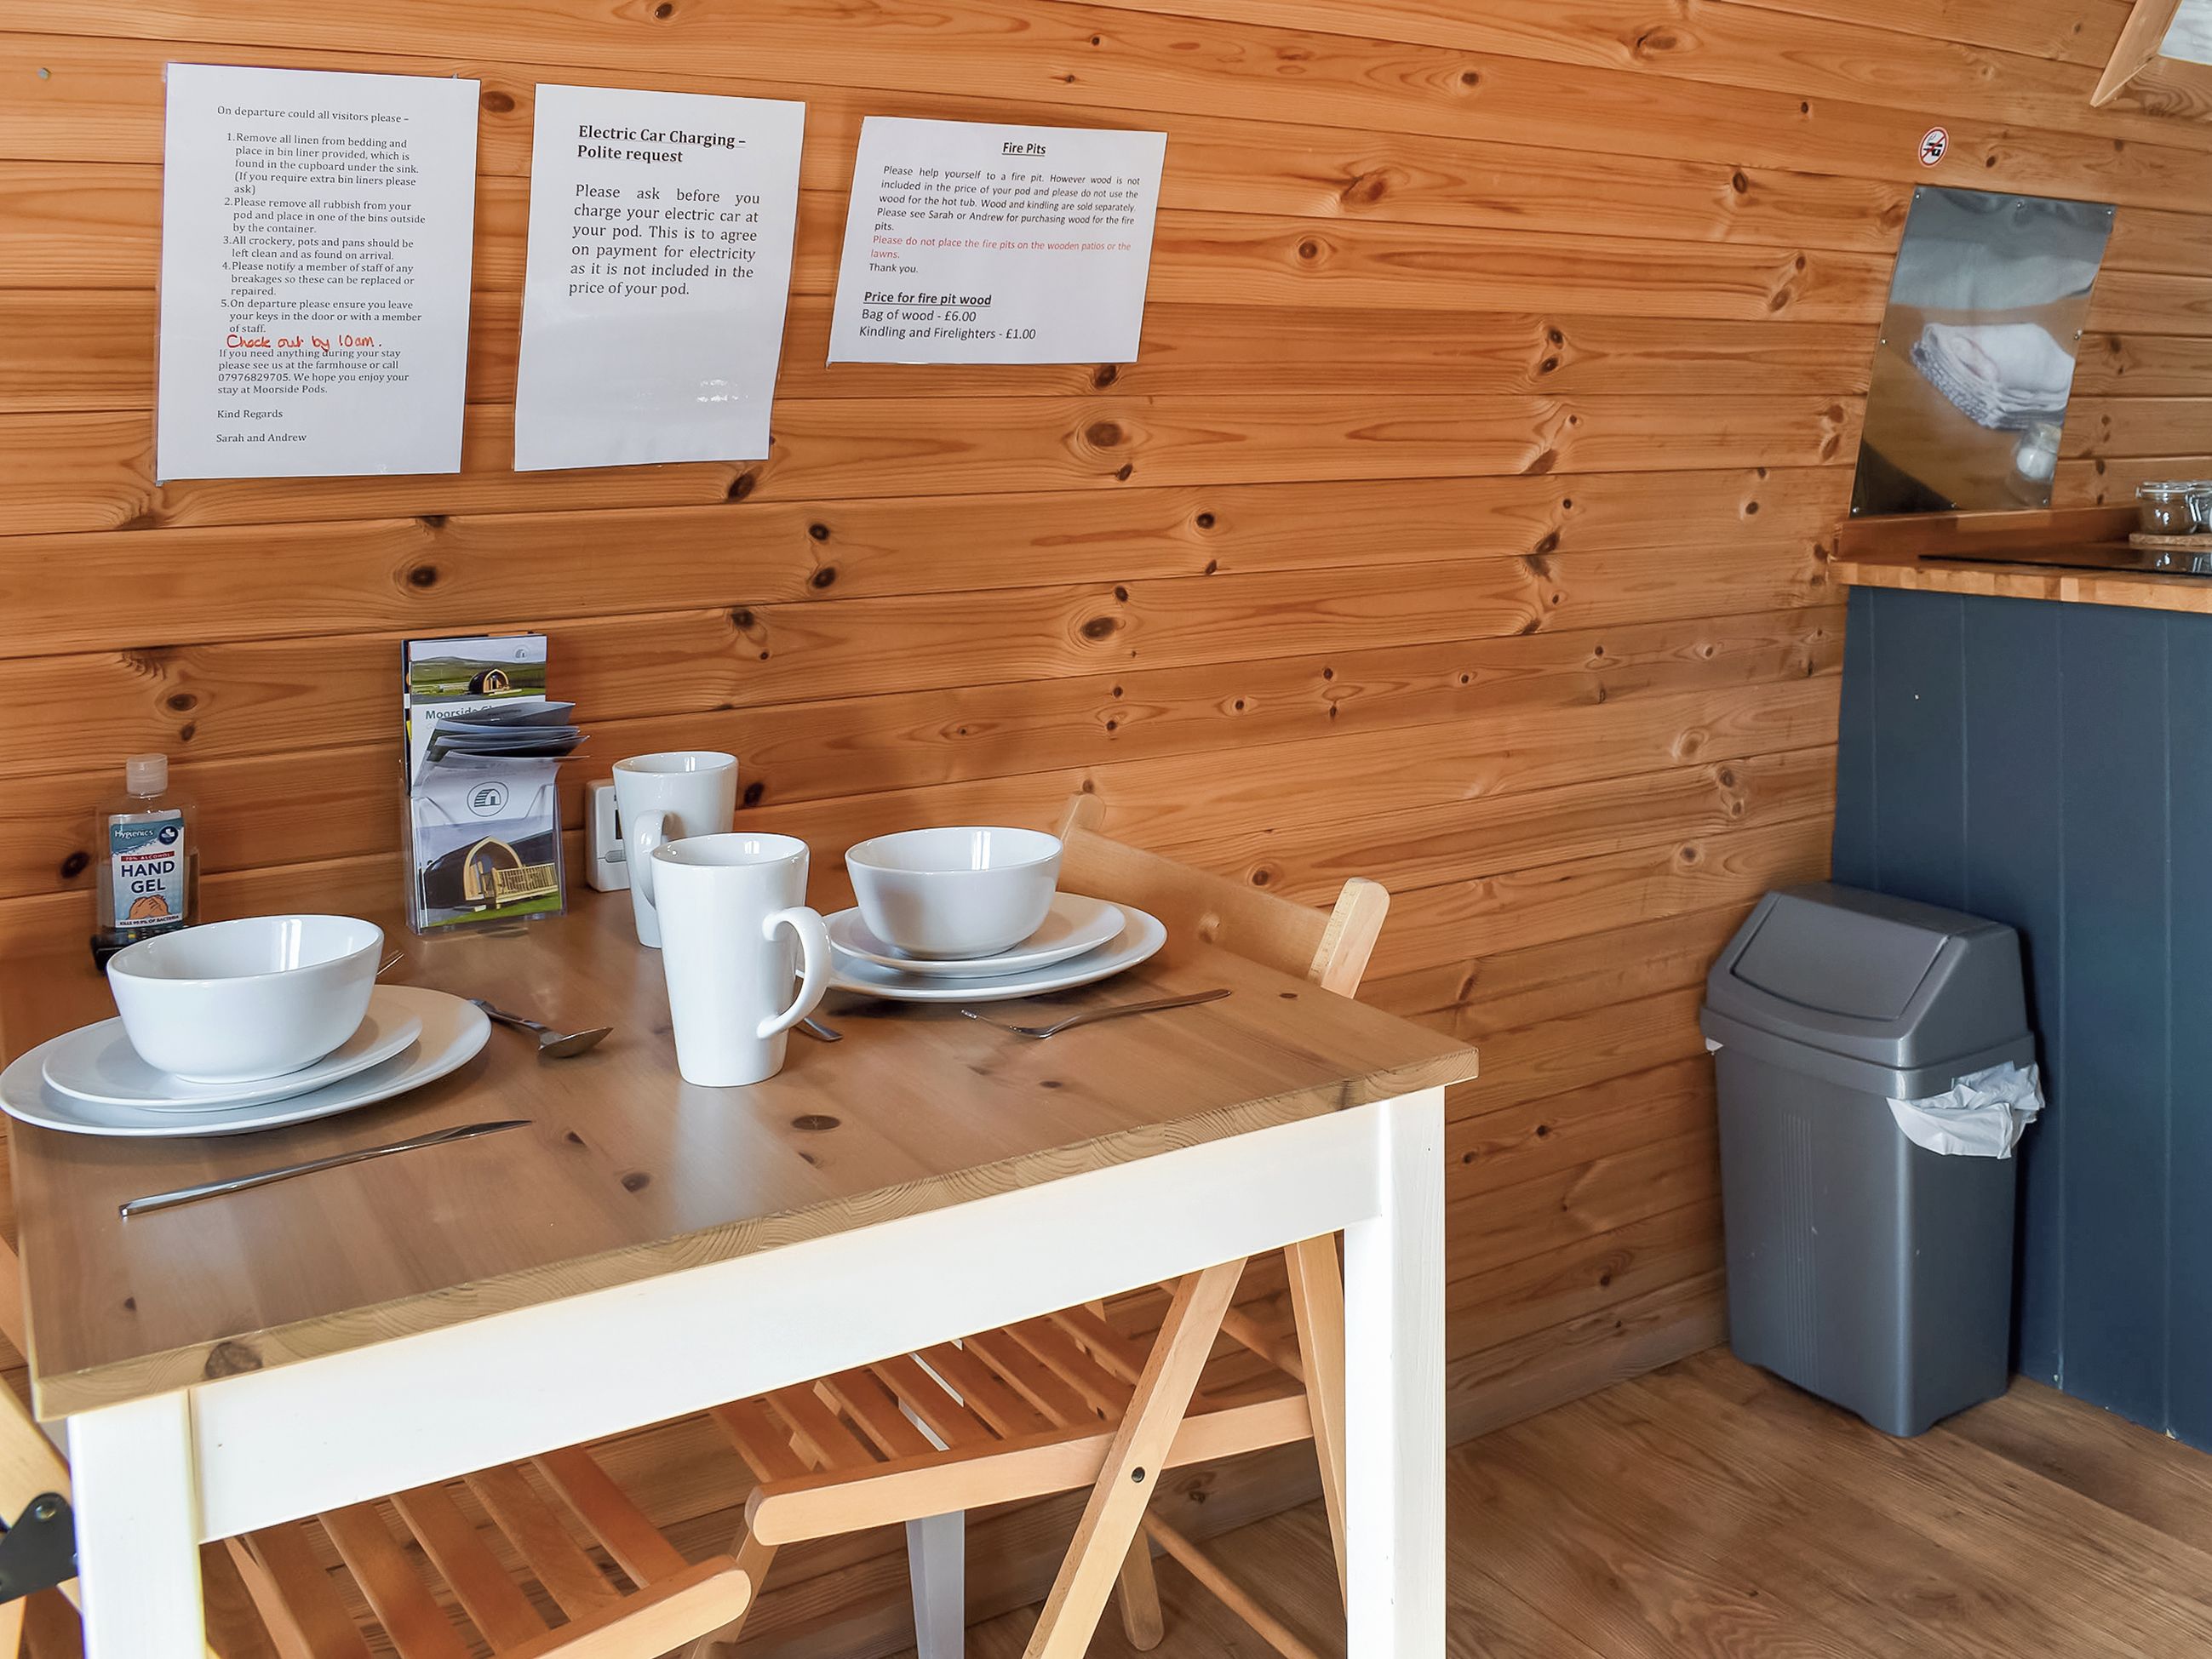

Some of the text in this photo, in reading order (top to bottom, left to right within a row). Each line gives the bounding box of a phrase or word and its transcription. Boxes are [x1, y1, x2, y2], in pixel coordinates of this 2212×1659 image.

[217, 105, 231, 115] On
[234, 106, 286, 118] departure
[287, 109, 315, 118] could
[317, 110, 329, 119] all
[331, 111, 368, 121] visitors
[370, 112, 401, 123] please
[578, 124, 636, 140] Electric
[640, 128, 666, 142] Car
[669, 130, 735, 149] Charging
[235, 145, 409, 160] place in bin liner provided, which is
[577, 144, 683, 164] Polite request
[1002, 141, 1046, 154] Fire Pits
[883, 165, 913, 176] Please
[918, 166, 939, 179] help
[944, 169, 981, 179] yourself
[986, 171, 996, 180] to
[1011, 171, 1025, 181] fire
[1030, 173, 1044, 183] pit.
[1049, 173, 1086, 183] However
[1090, 175, 1112, 184] wood
[1116, 176, 1122, 184] is
[1126, 177, 1140, 185] not
[233, 184, 255, 195] ask)
[575, 183, 759, 207] Please ask before you
[878, 194, 905, 203] wood
[907, 194, 922, 204] for
[924, 195, 939, 205] the
[941, 196, 957, 206] hot
[959, 197, 977, 207] tub.
[980, 198, 1007, 208] Wood
[1008, 199, 1025, 209] and
[1026, 200, 1059, 212] kindling
[1076, 201, 1093, 211] sold
[573, 202, 759, 223] charge your electric car at
[232, 222, 316, 234] by the container.
[571, 224, 757, 244] your pod. This is to agree
[873, 221, 894, 232] pits.
[872, 234, 903, 245] Please
[905, 236, 917, 245] do
[937, 237, 962, 248] place
[964, 238, 979, 248] the
[982, 239, 997, 248] fire
[999, 239, 1015, 250] pits
[1030, 240, 1045, 249] the
[1047, 241, 1079, 250] wooden
[1080, 241, 1104, 252] patios
[1117, 241, 1131, 251] the
[571, 244, 756, 263] on payment for electricity
[870, 248, 899, 258] lawns.
[569, 262, 754, 278] as it is not included in the
[868, 262, 918, 274] Thank you.
[231, 273, 282, 285] breakages
[298, 274, 325, 284] these
[346, 275, 358, 284] be
[360, 275, 401, 286] replaced
[230, 286, 276, 297] repaired.
[568, 281, 689, 297] price of your pod.
[863, 291, 992, 308] Price for fire pit wood
[861, 308, 884, 322] Bag
[886, 308, 900, 320] of
[901, 309, 934, 321] wood
[944, 310, 976, 322] £6.00
[229, 323, 266, 333] of staff.
[858, 325, 906, 340] Kindling
[908, 326, 931, 338] and
[933, 327, 996, 341] Firelighters
[1005, 328, 1036, 339] £1.00
[226, 333, 271, 348] Check
[277, 335, 304, 348] out
[311, 335, 331, 353] by
[217, 372, 409, 383] 07976829705. We hope you enjoy your
[217, 386, 238, 396] stay
[252, 384, 299, 394] Moorside
[301, 384, 327, 393] Pods.
[217, 409, 283, 420] Kind Regards
[216, 432, 307, 443] Sarah and Andrew
[115, 830, 154, 839] Hygienics
[121, 861, 175, 877] HAND
[131, 878, 166, 893] GEL
